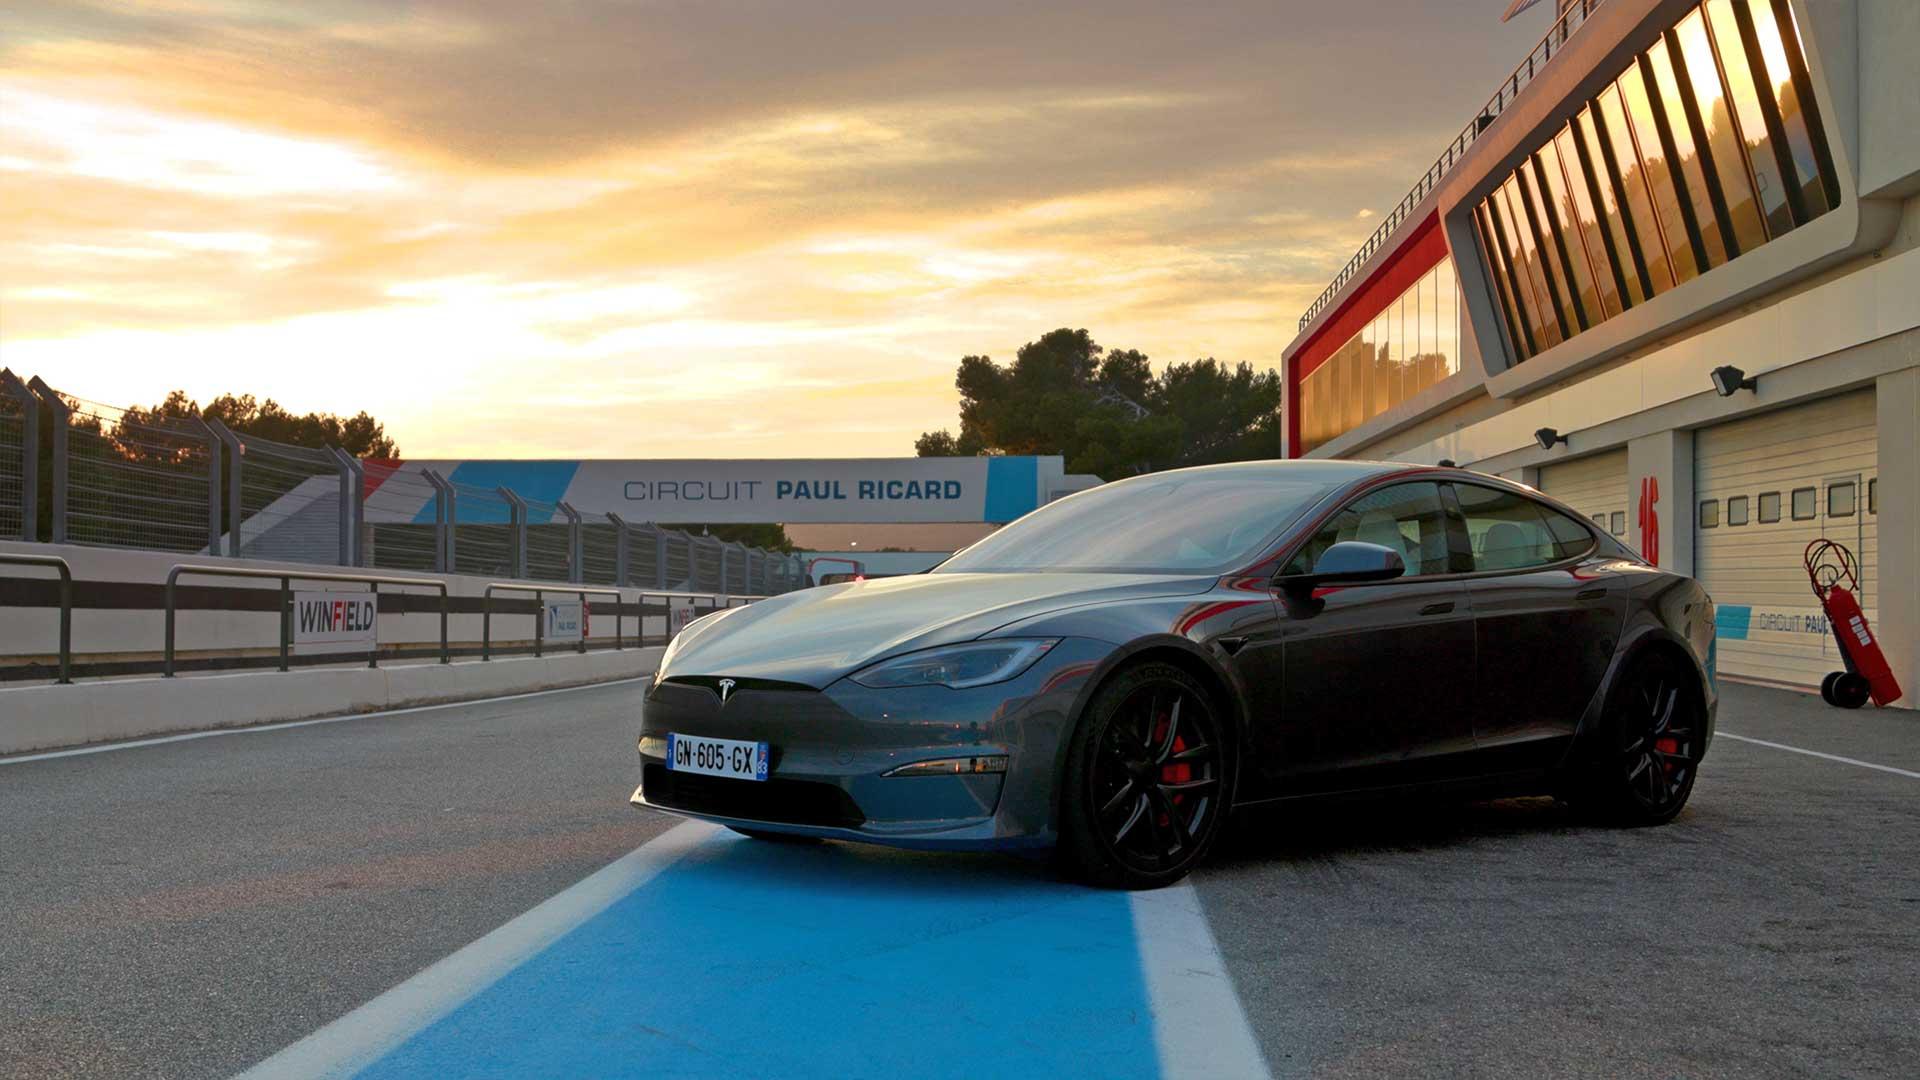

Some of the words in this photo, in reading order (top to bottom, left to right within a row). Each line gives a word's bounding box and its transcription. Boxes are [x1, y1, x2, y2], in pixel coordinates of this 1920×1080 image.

[624, 481, 762, 501] CIRCUIT
[776, 480, 847, 500] PAUL
[858, 480, 962, 500] RICARD
[1638, 476, 1659, 567] 16
[300, 600, 374, 633] WINFIELD
[1759, 612, 1801, 632] CIRCUIT
[676, 739, 753, 774] GN-605-GX
[757, 761, 768, 774] 83
